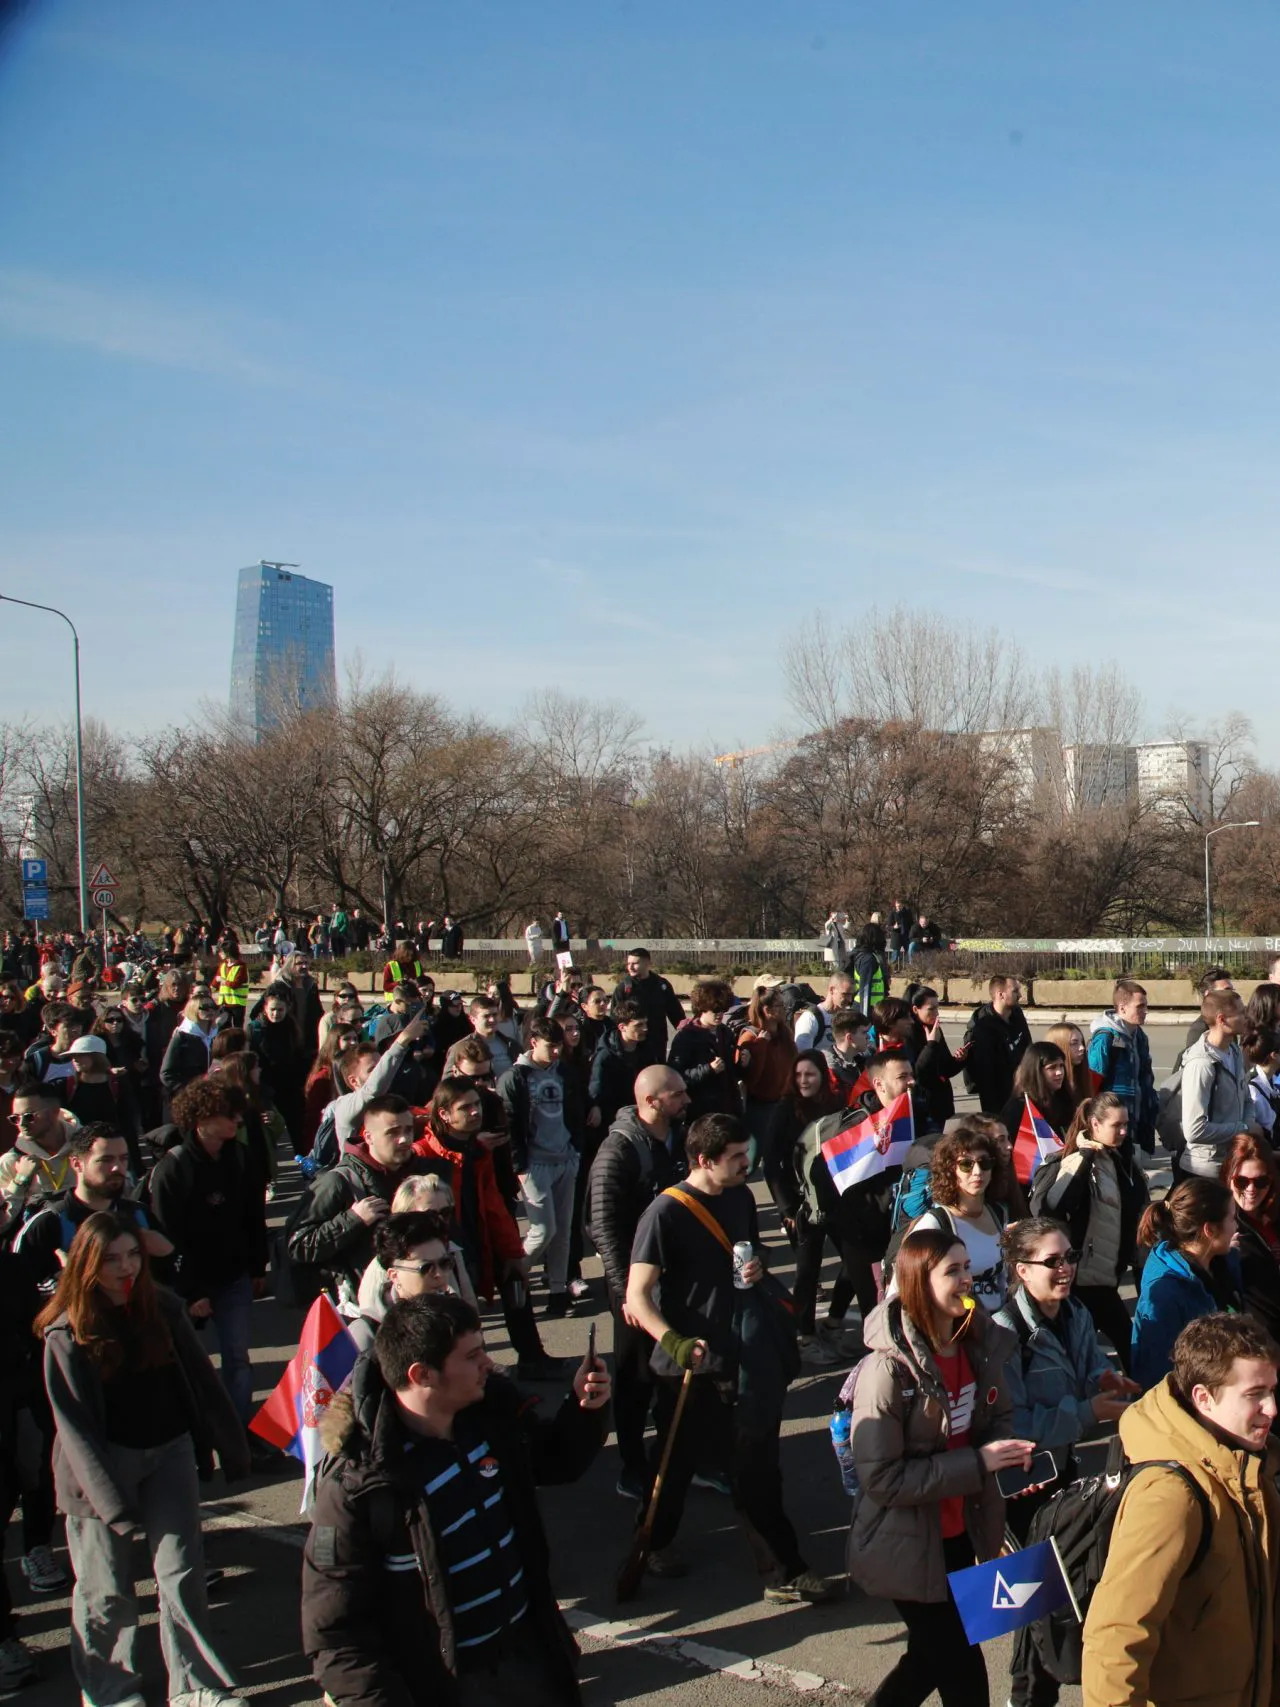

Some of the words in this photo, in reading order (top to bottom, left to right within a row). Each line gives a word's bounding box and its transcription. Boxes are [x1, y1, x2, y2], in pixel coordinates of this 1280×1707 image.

[27, 861, 42, 879] P
[99, 893, 112, 904] 40
[1131, 938, 1167, 951] 2005
